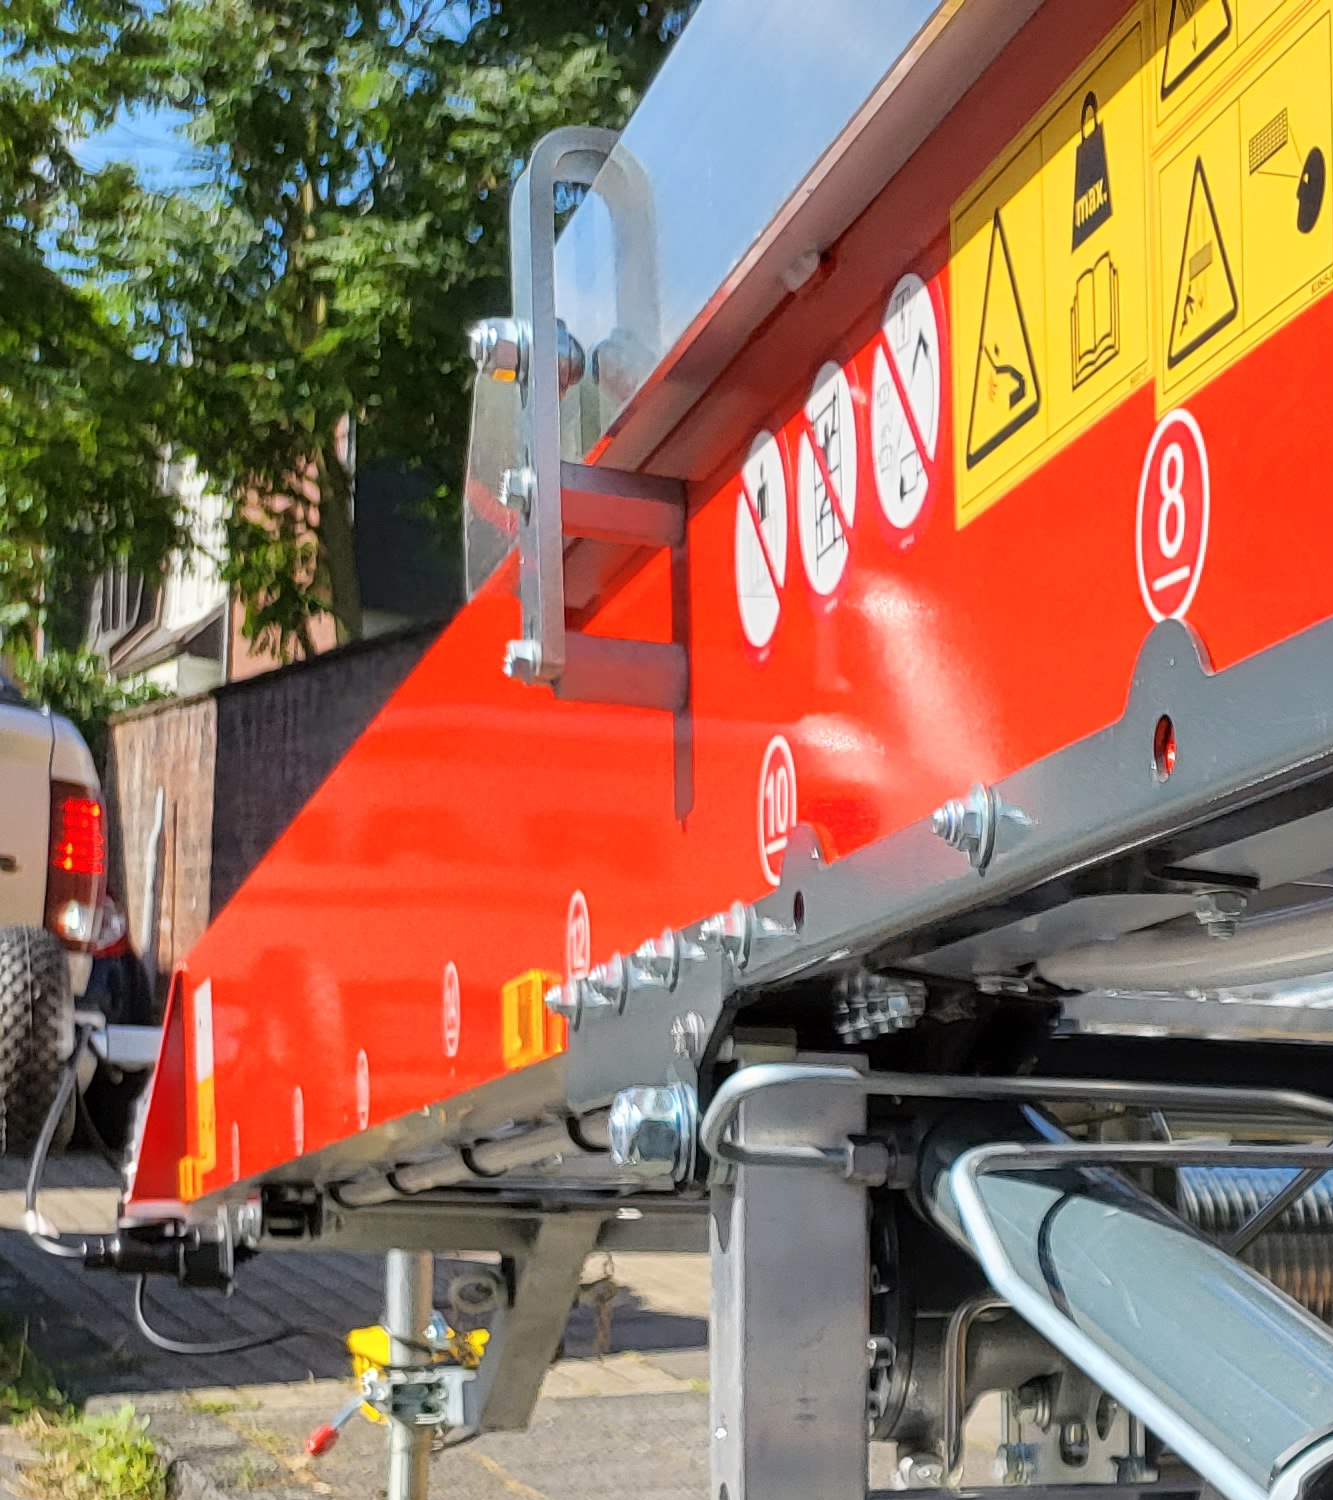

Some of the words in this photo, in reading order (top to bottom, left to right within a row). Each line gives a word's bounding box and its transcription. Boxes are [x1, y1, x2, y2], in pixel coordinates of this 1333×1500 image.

[1074, 177, 1108, 229] max.
[1158, 441, 1186, 559] 8
[765, 765, 789, 838] 10
